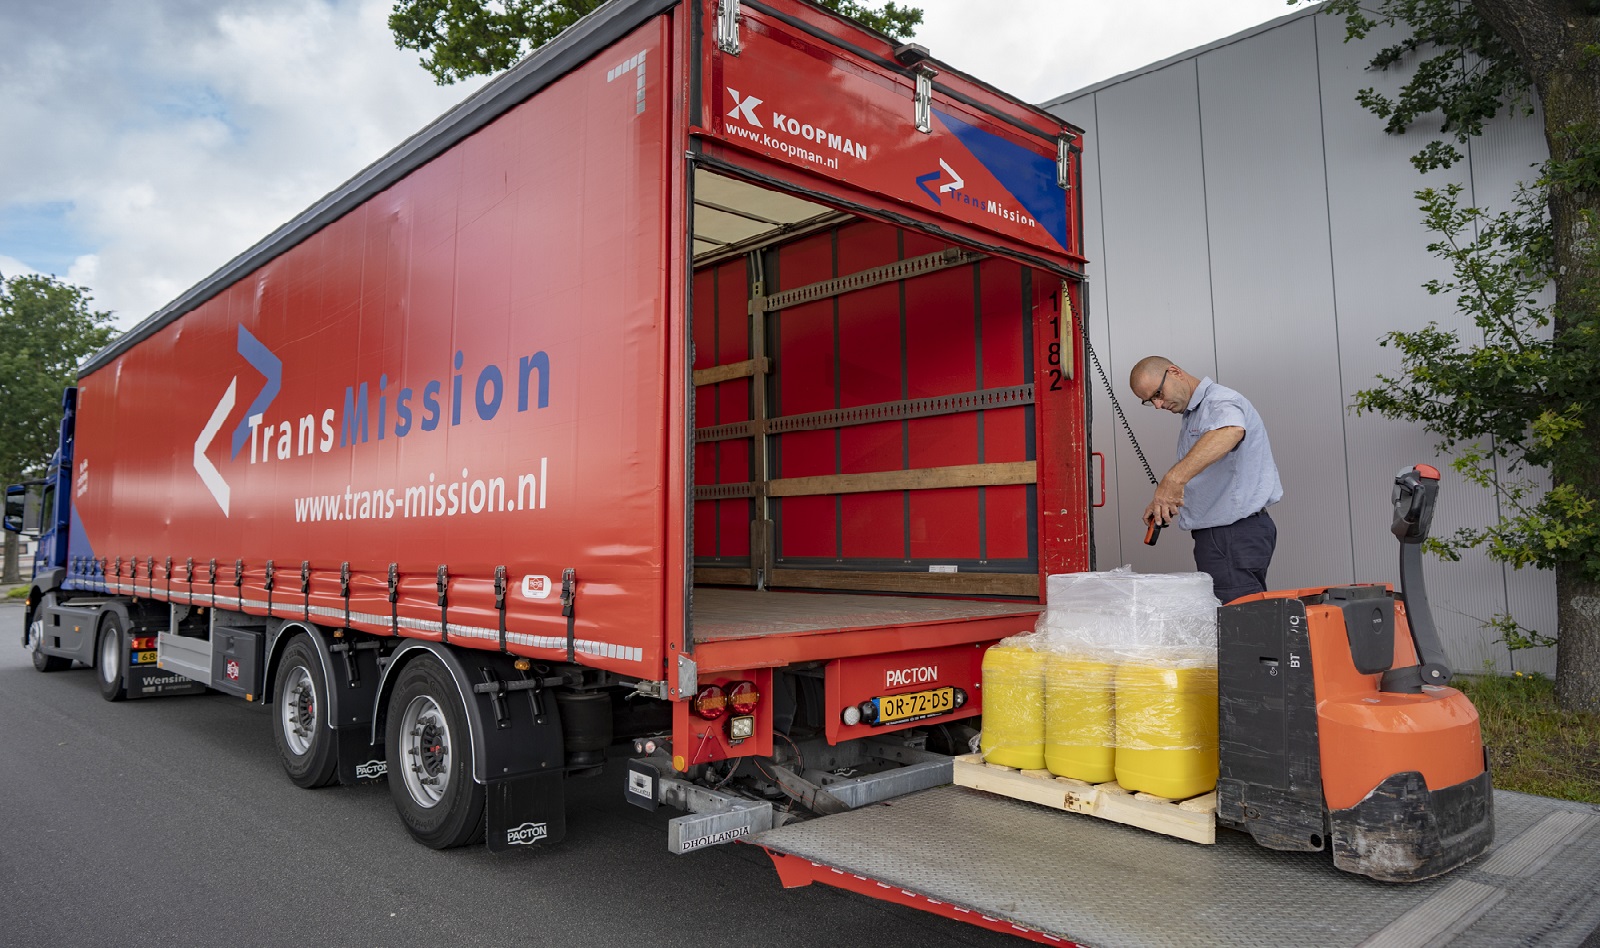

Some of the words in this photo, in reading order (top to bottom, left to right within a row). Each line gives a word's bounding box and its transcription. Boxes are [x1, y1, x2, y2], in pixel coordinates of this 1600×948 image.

[725, 123, 839, 170] www.koopman.nl
[773, 112, 867, 160] KOOPMAN
[949, 186, 1035, 228] TransMission
[248, 350, 550, 464] TransMission
[295, 457, 548, 522] www.trans-mission.nl
[886, 666, 938, 687] PACTON
[1290, 652, 1301, 668] BT
[885, 691, 949, 717] OR-72-DS
[508, 825, 547, 842] PACTON
[683, 826, 749, 850] DHOLLANDIA
